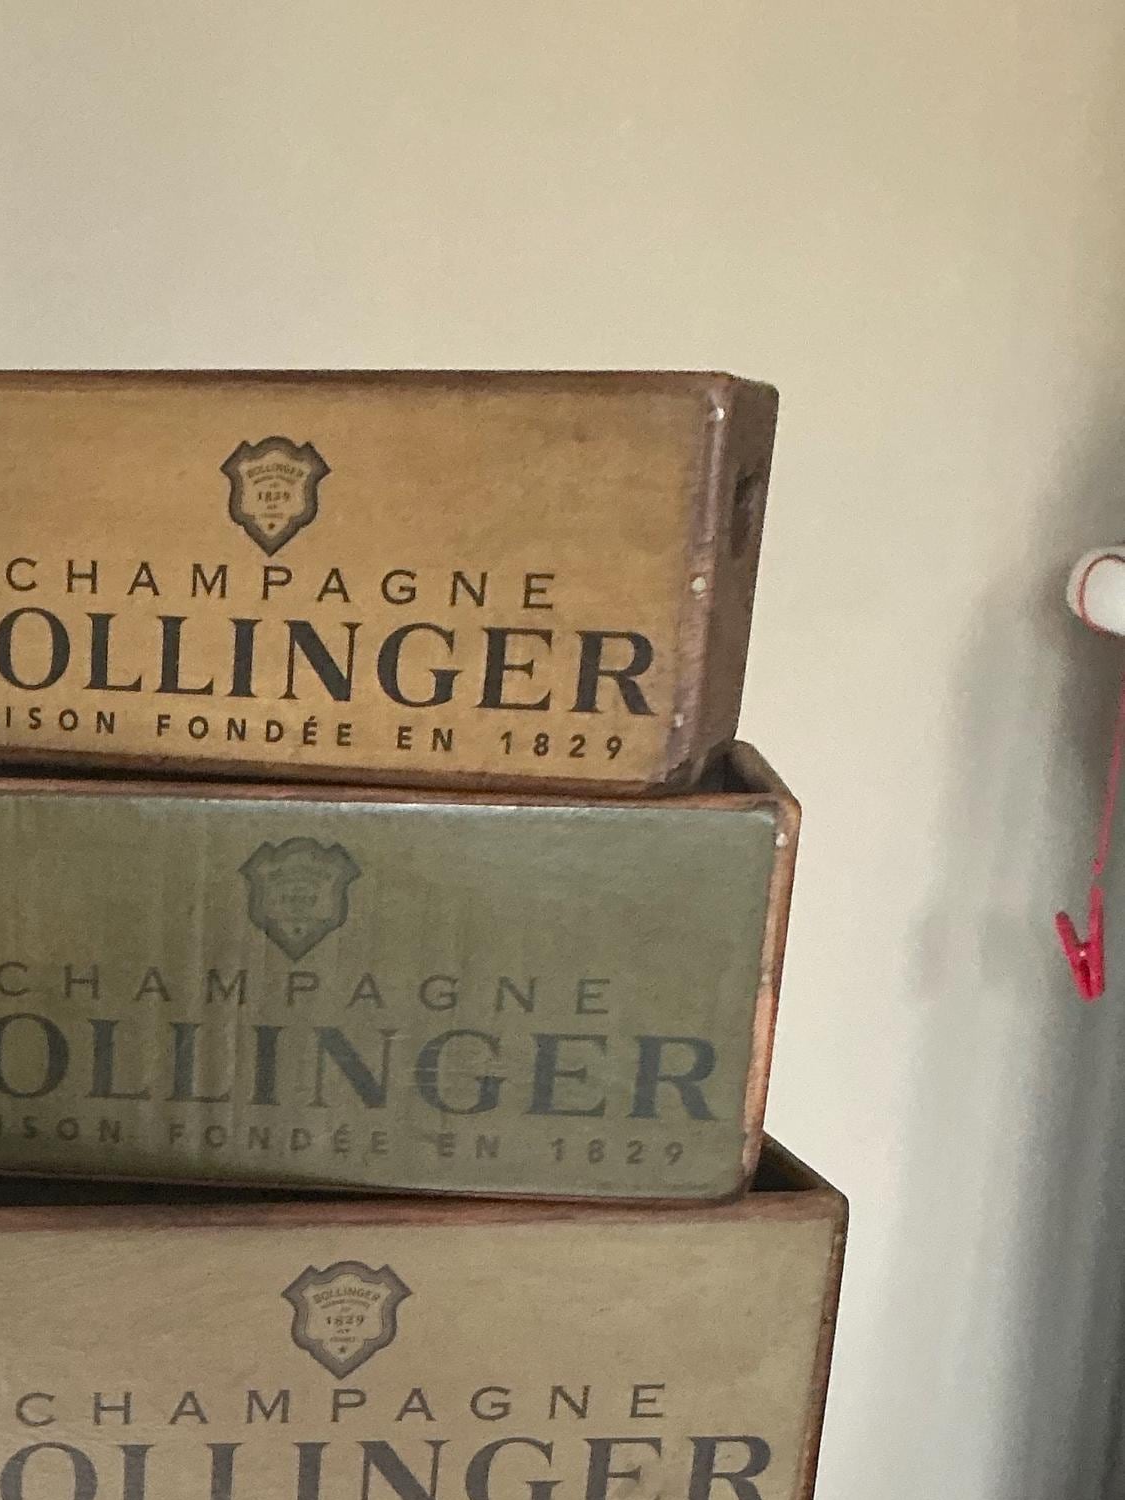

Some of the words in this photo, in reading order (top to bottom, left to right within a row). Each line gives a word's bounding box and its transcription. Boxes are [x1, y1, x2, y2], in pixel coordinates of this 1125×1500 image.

[6, 558, 556, 610] CHAMPAGNE
[157, 714, 353, 748] FONDÉE
[397, 725, 454, 753] EN
[500, 731, 625, 761] 1829
[169, 1120, 388, 1157] FONDÉE
[440, 1133, 500, 1160] EN
[552, 1138, 685, 1165] 1829
[15, 1384, 666, 1427] CHAMPAGNE
